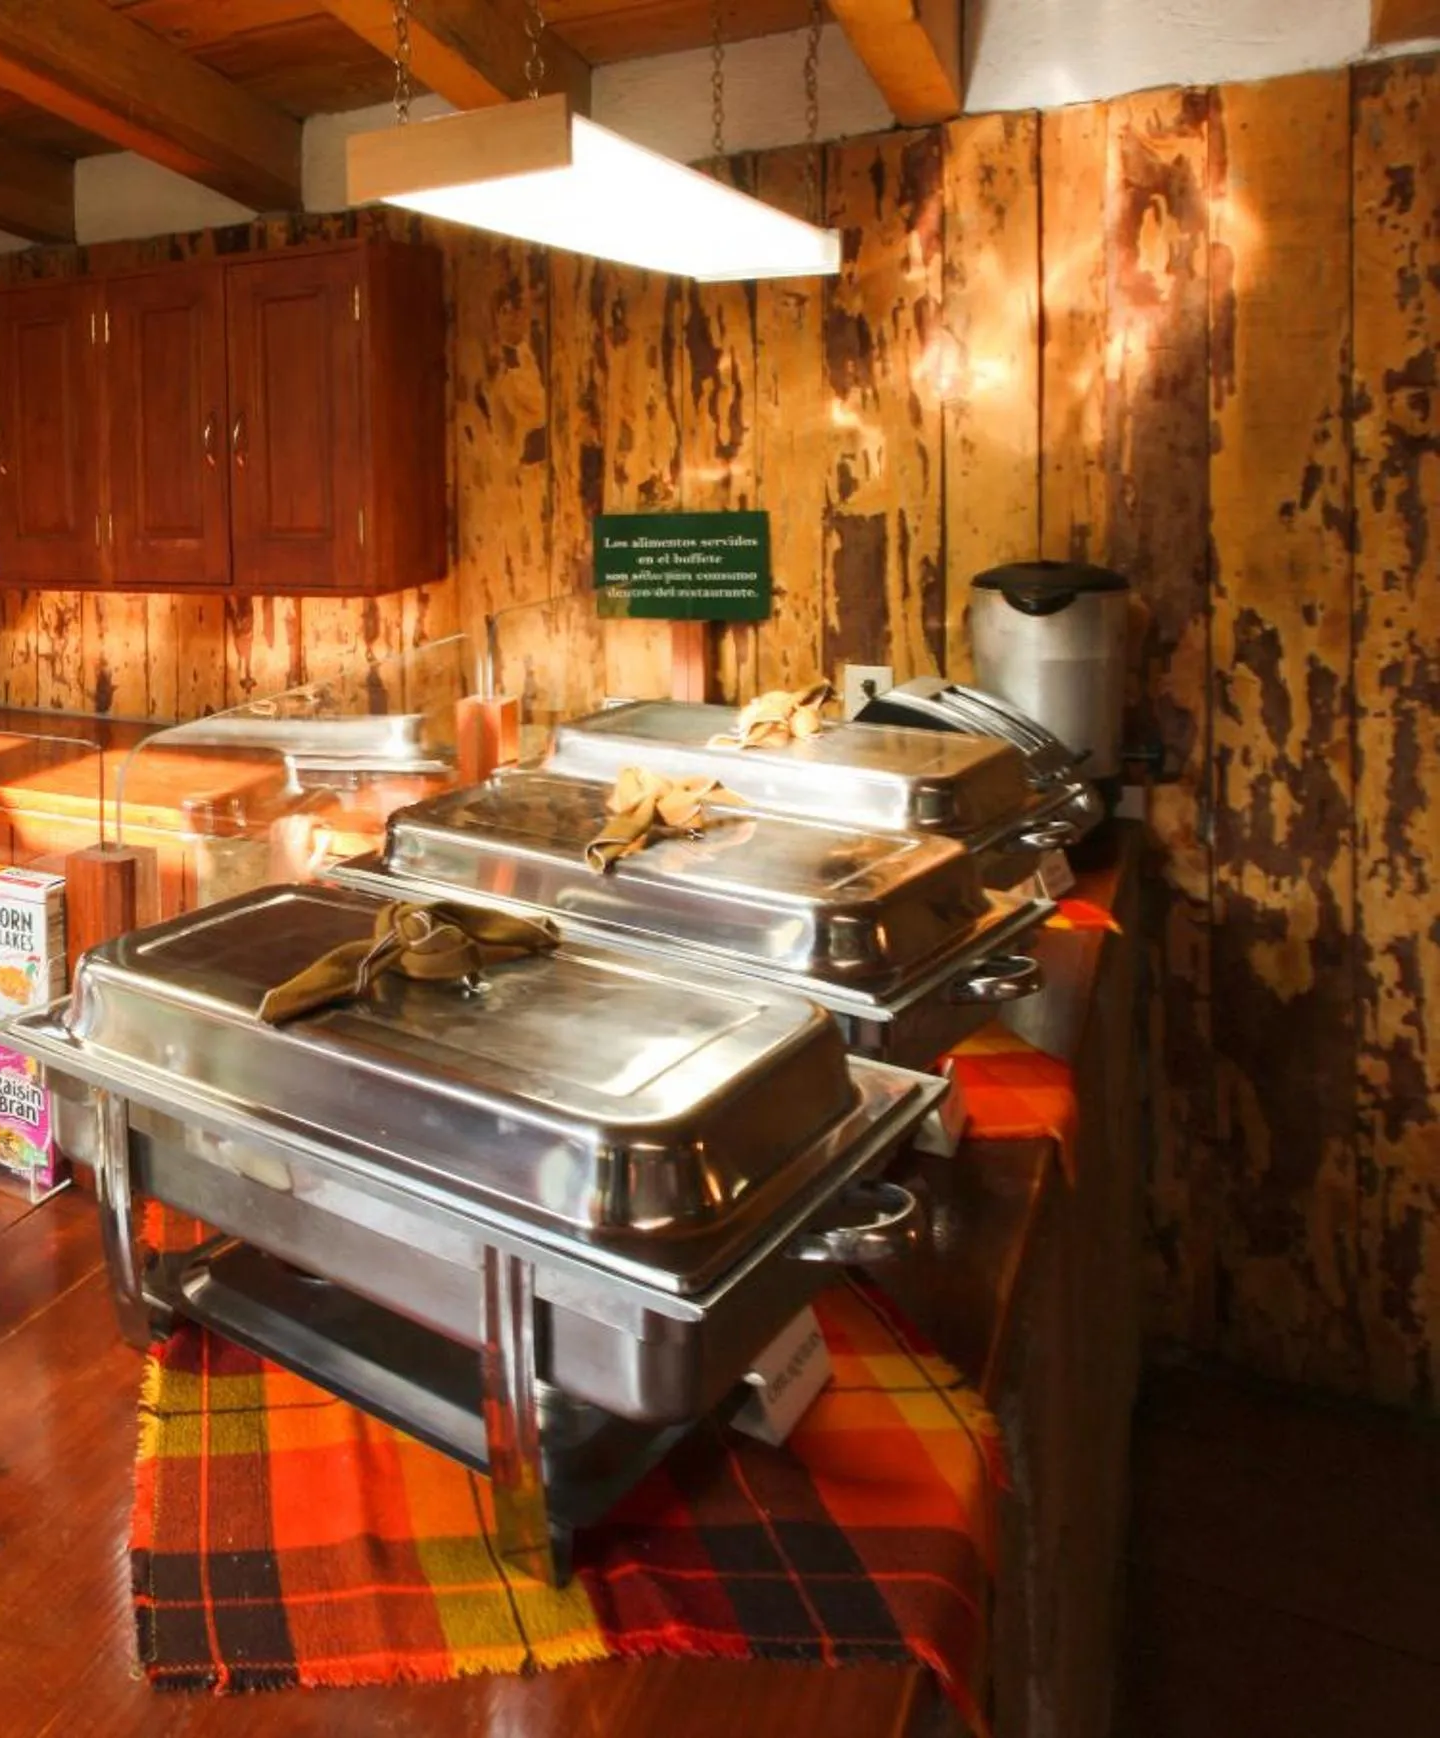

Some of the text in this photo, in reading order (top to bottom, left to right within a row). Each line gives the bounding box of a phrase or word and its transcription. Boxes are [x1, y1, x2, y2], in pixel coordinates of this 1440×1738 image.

[604, 535, 758, 549] Los alimentos servidos
[638, 556, 654, 564] en
[657, 553, 670, 565] el
[605, 573, 629, 581] son
[695, 571, 757, 581] consumo
[607, 585, 759, 598] dentro del restaurante.
